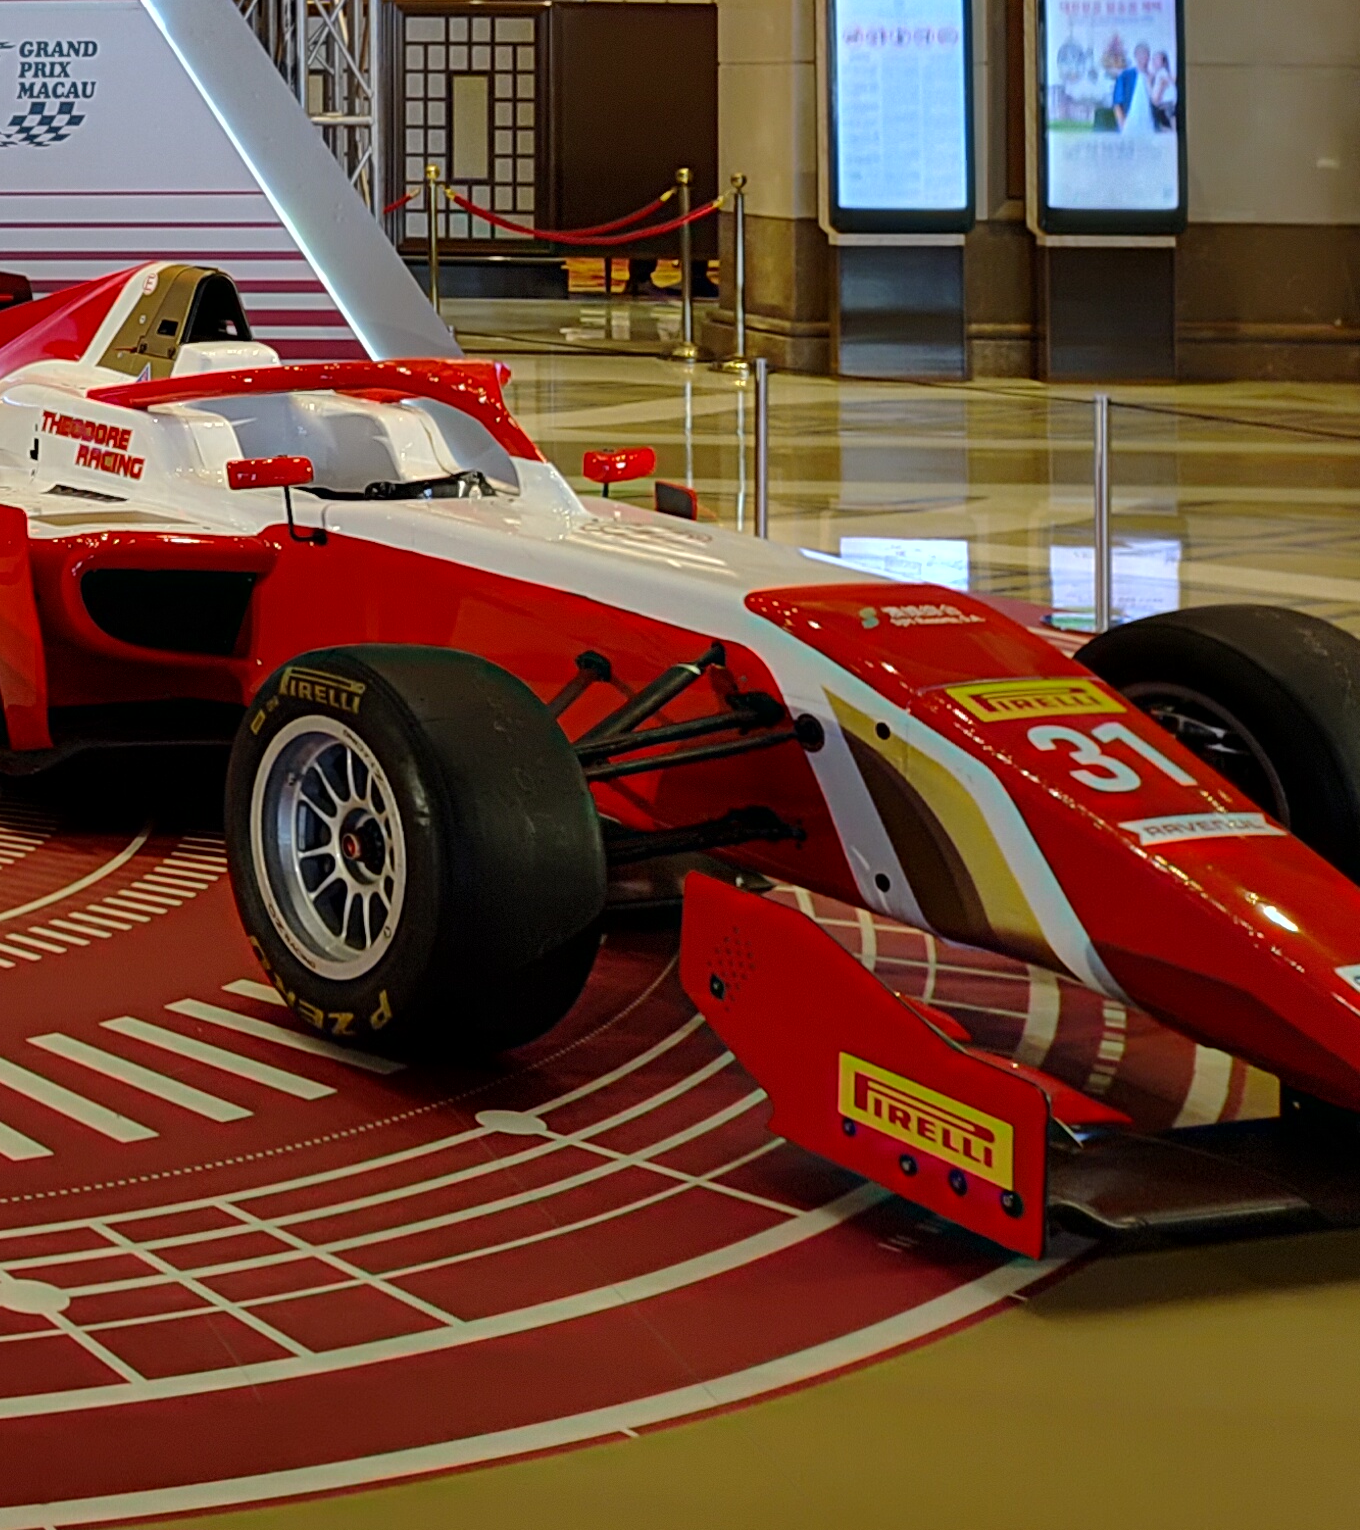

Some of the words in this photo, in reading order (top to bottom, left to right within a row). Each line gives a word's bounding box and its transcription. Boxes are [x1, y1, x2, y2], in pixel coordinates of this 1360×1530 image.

[19, 40, 98, 58] GRAND
[18, 61, 71, 78] PRIX
[16, 81, 96, 99] MACAU
[41, 409, 133, 451] THEODORE
[75, 443, 146, 480] RACING
[279, 666, 366, 714] PIRELLI
[969, 687, 1103, 713] PIRELLI
[1027, 722, 1198, 792] 31
[854, 1071, 995, 1169] PIRELLI
